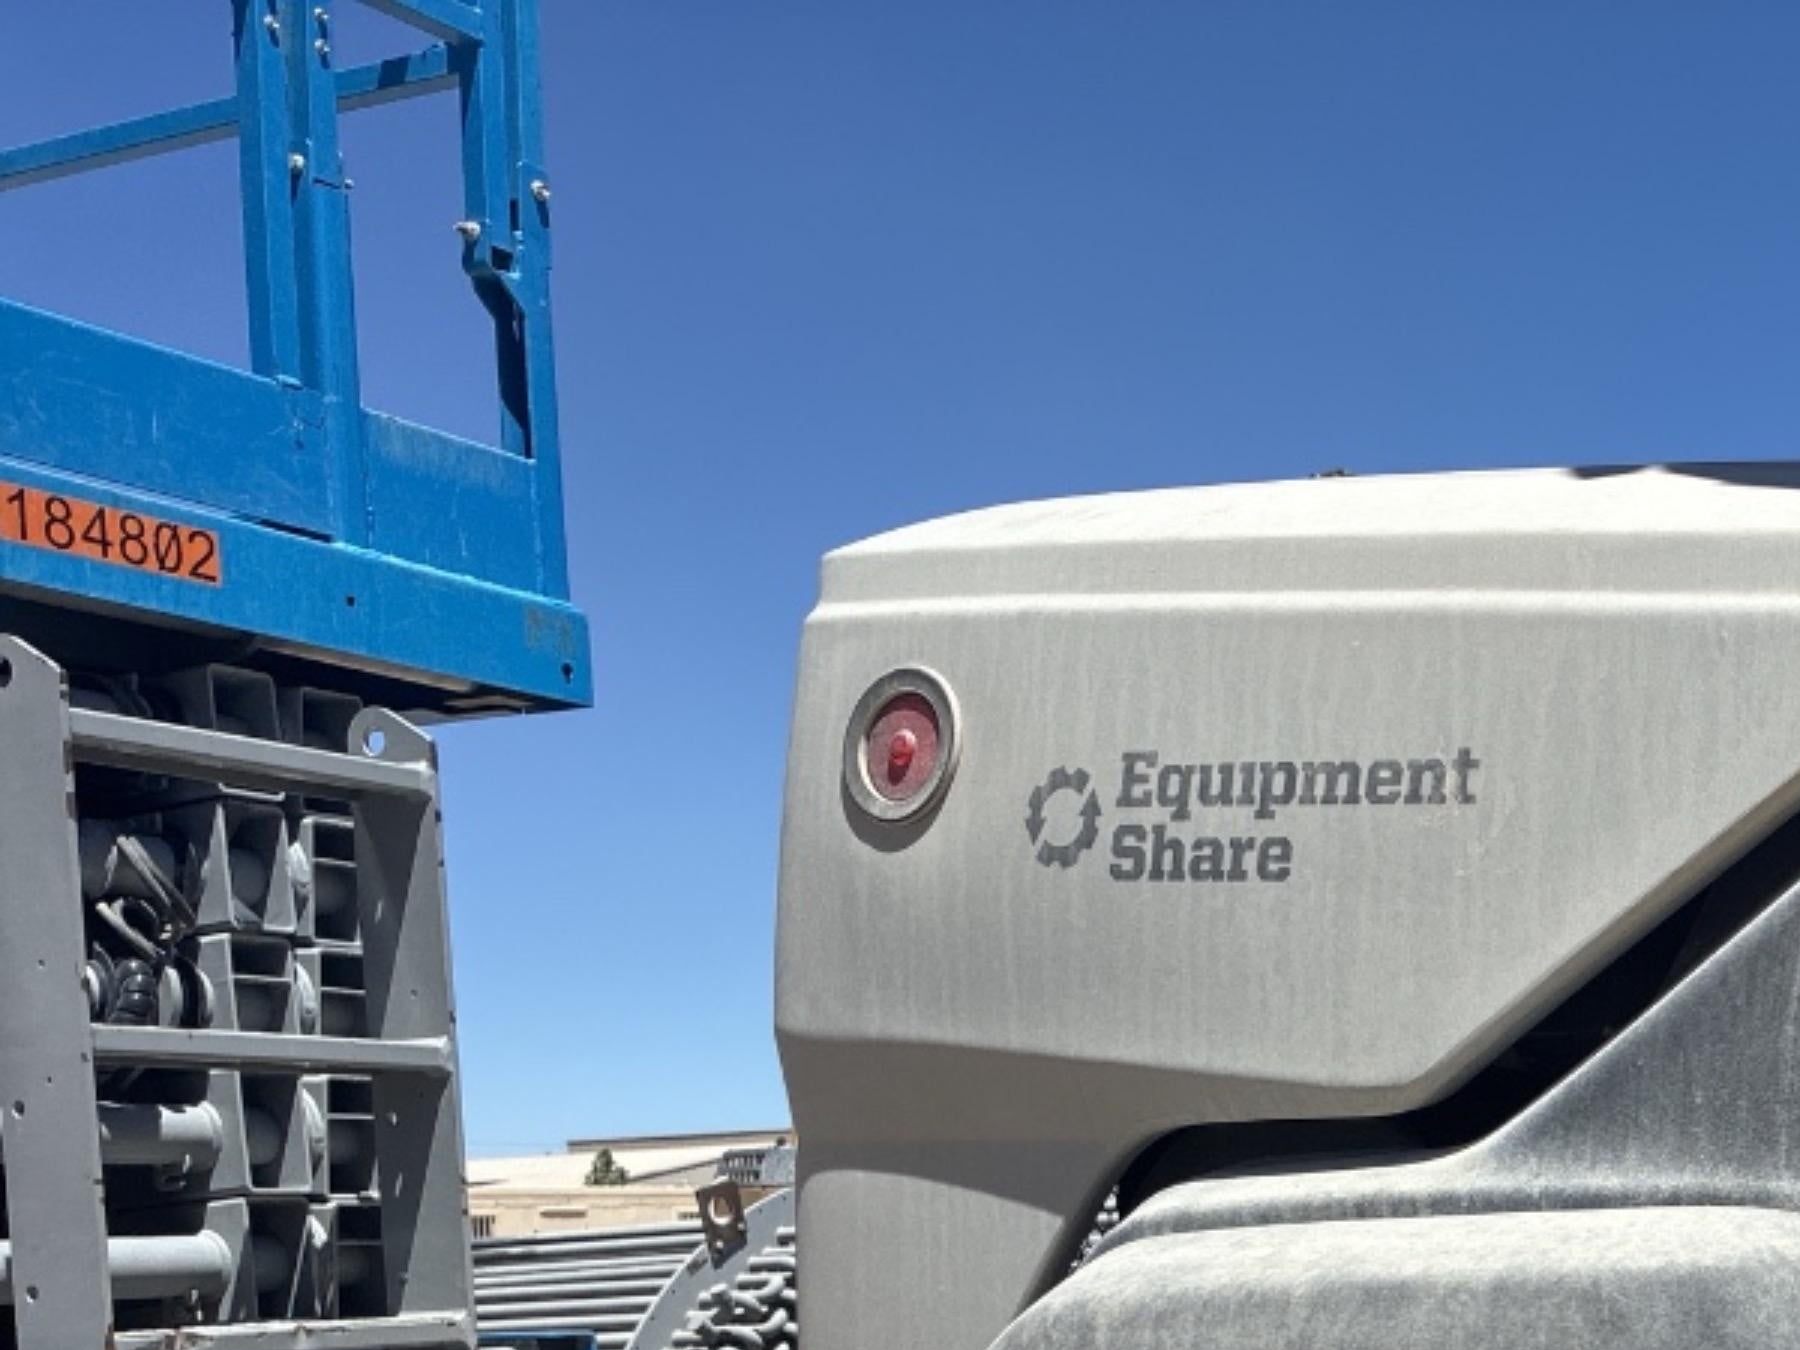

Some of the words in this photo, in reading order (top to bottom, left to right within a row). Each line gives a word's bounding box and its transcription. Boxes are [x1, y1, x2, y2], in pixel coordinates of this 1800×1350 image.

[6, 487, 218, 583] 184802
[1114, 747, 1481, 821] Equipment
[1108, 822, 1294, 883] Share
